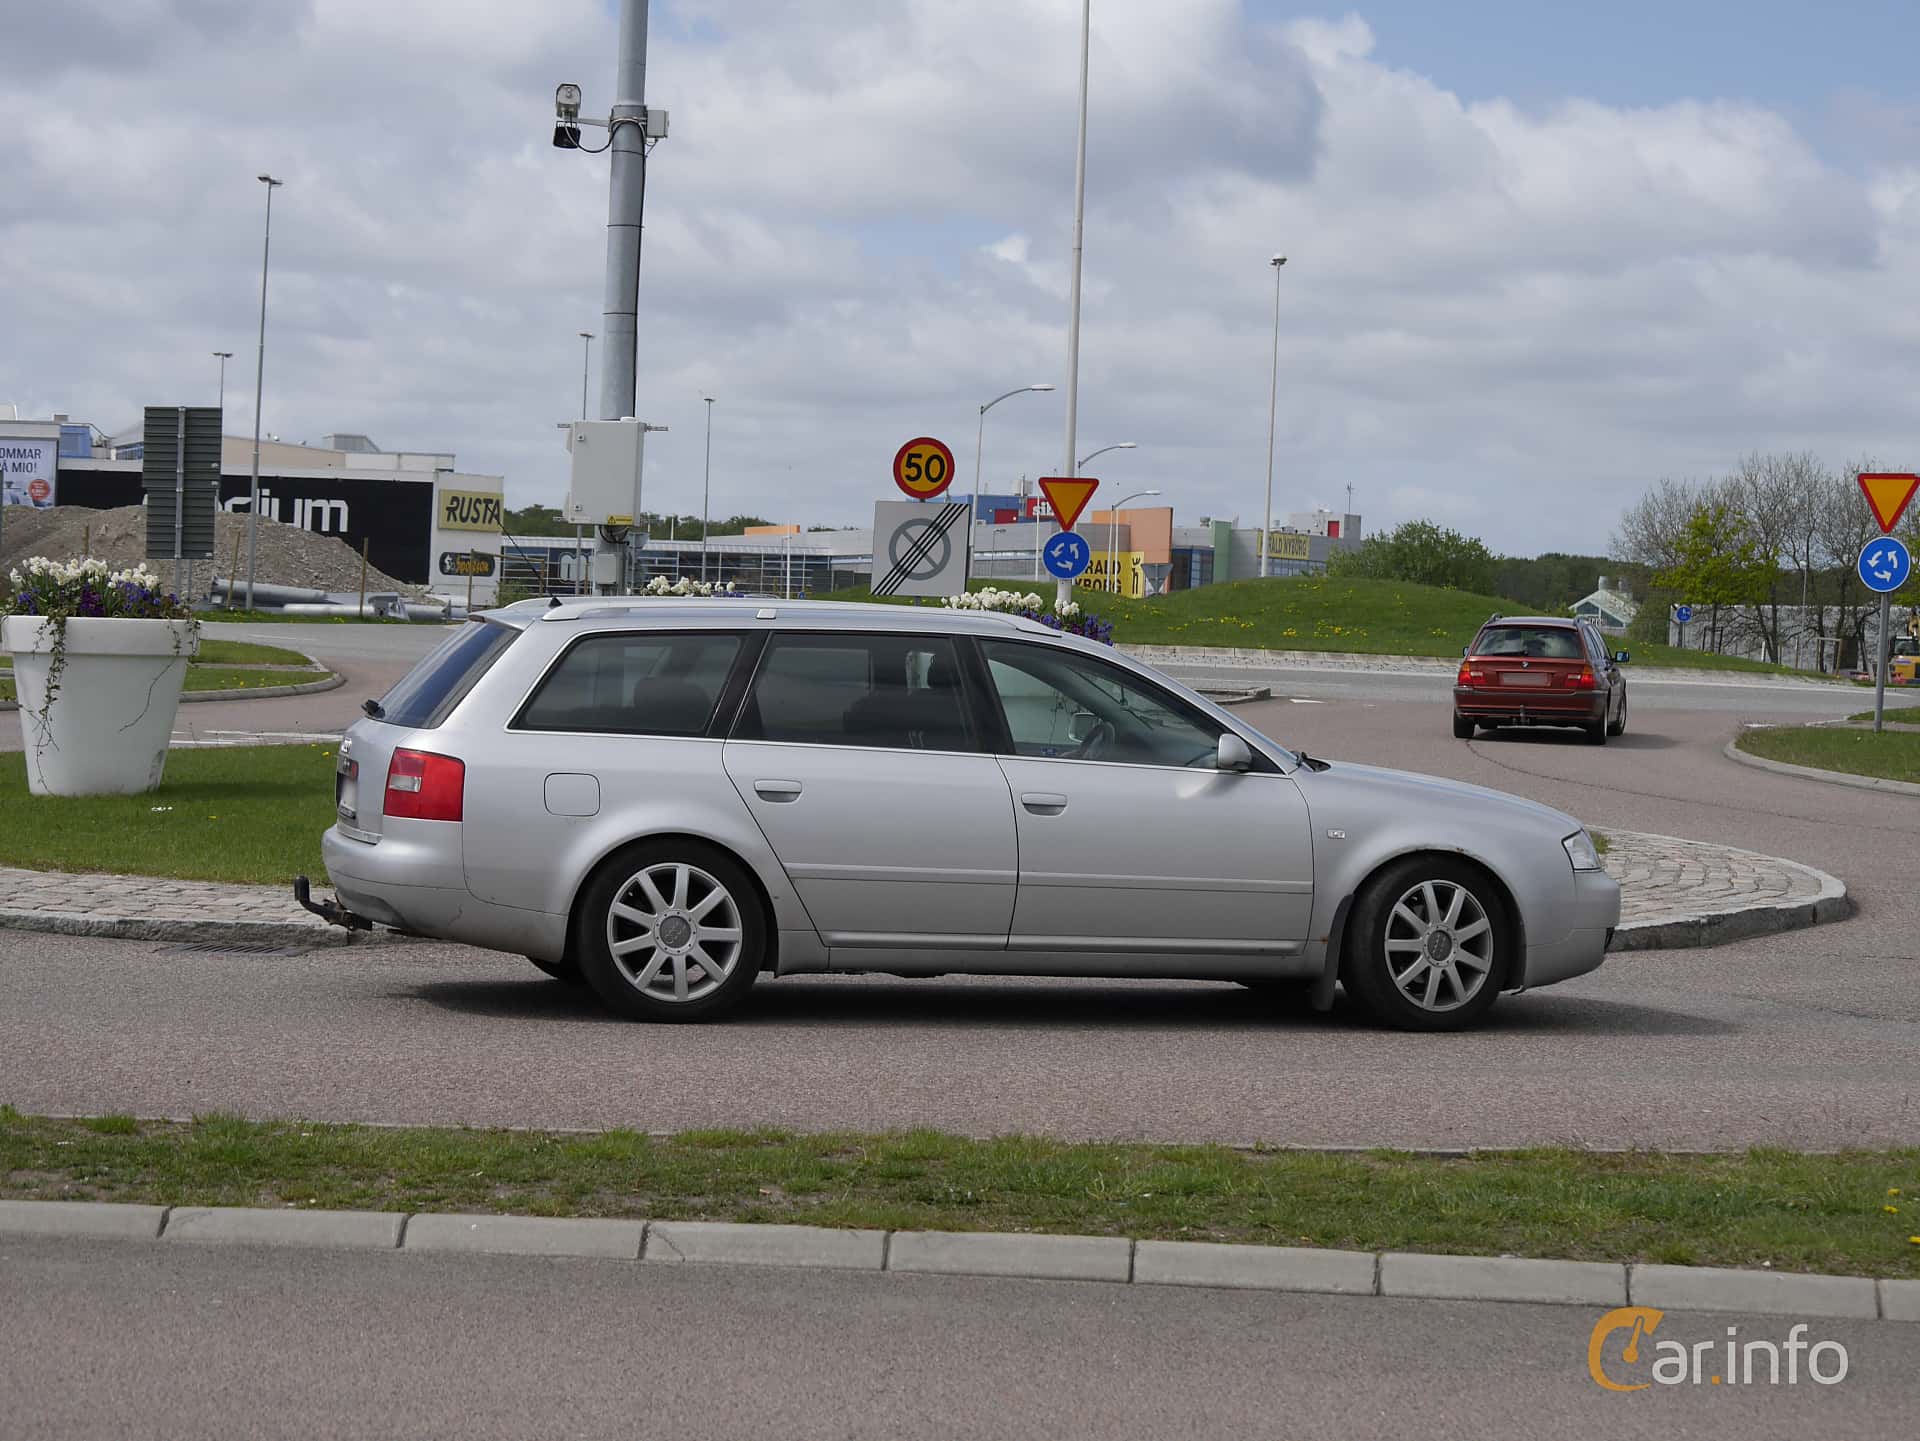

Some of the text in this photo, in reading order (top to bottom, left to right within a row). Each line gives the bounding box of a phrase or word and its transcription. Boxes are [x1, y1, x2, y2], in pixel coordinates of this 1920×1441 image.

[12, 461, 37, 473] MIO!
[905, 453, 946, 483] 50
[445, 495, 501, 525] RUSTA
